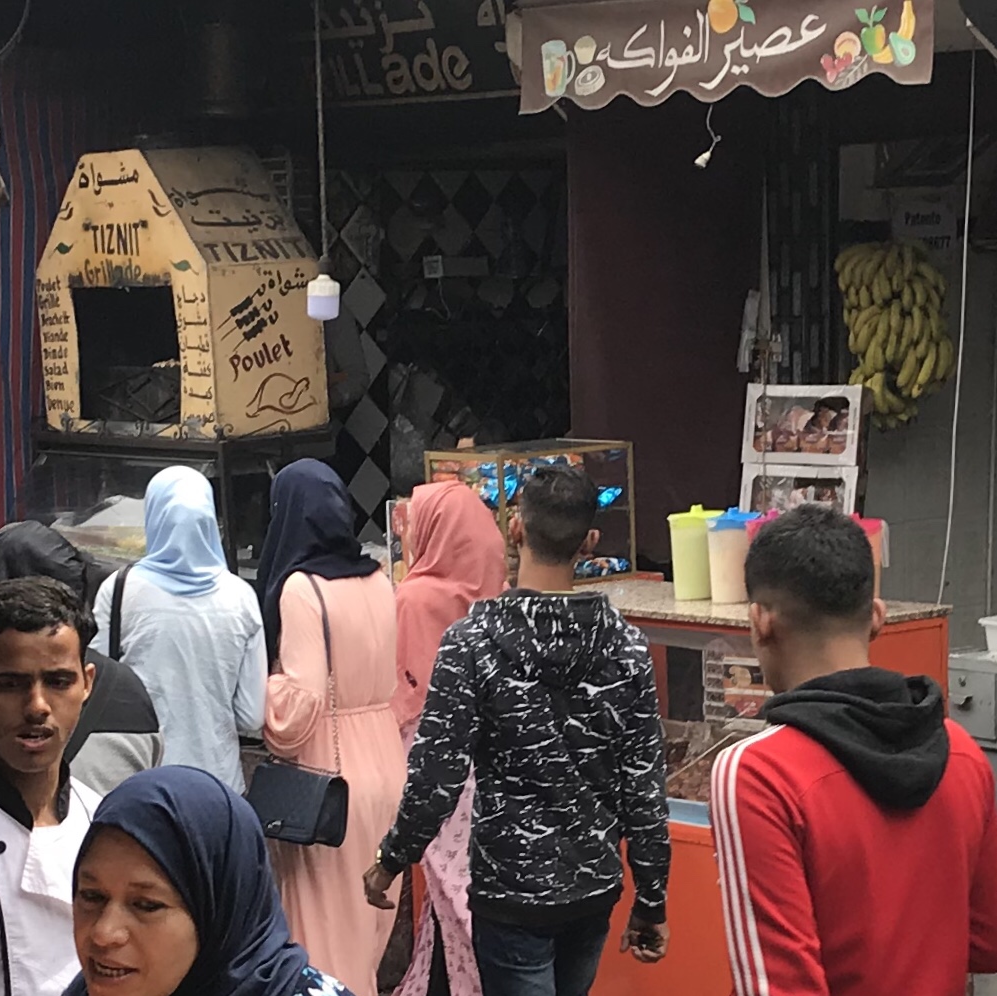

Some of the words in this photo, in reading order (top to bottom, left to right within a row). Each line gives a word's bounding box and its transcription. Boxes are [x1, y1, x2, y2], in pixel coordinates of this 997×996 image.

[698, 13, 828, 90] عصير
[203, 238, 307, 263] TIZNIT
[229, 333, 294, 382] Poulet
